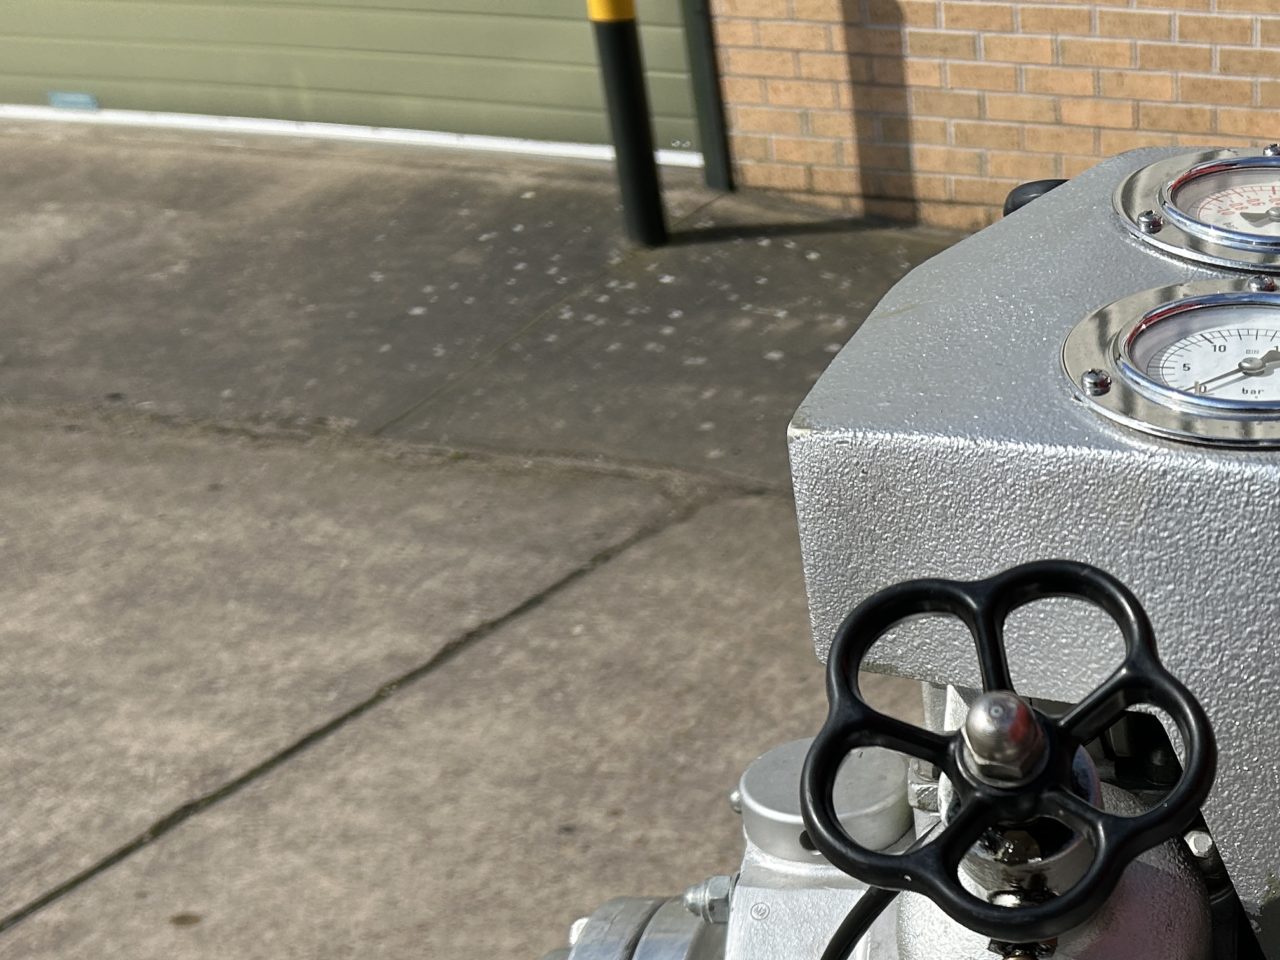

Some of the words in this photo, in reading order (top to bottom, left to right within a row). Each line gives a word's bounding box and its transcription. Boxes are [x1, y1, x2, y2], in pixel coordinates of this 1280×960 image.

[1213, 344, 1227, 353] 10
[1182, 363, 1191, 372] 5
[1242, 386, 1264, 395] bar
